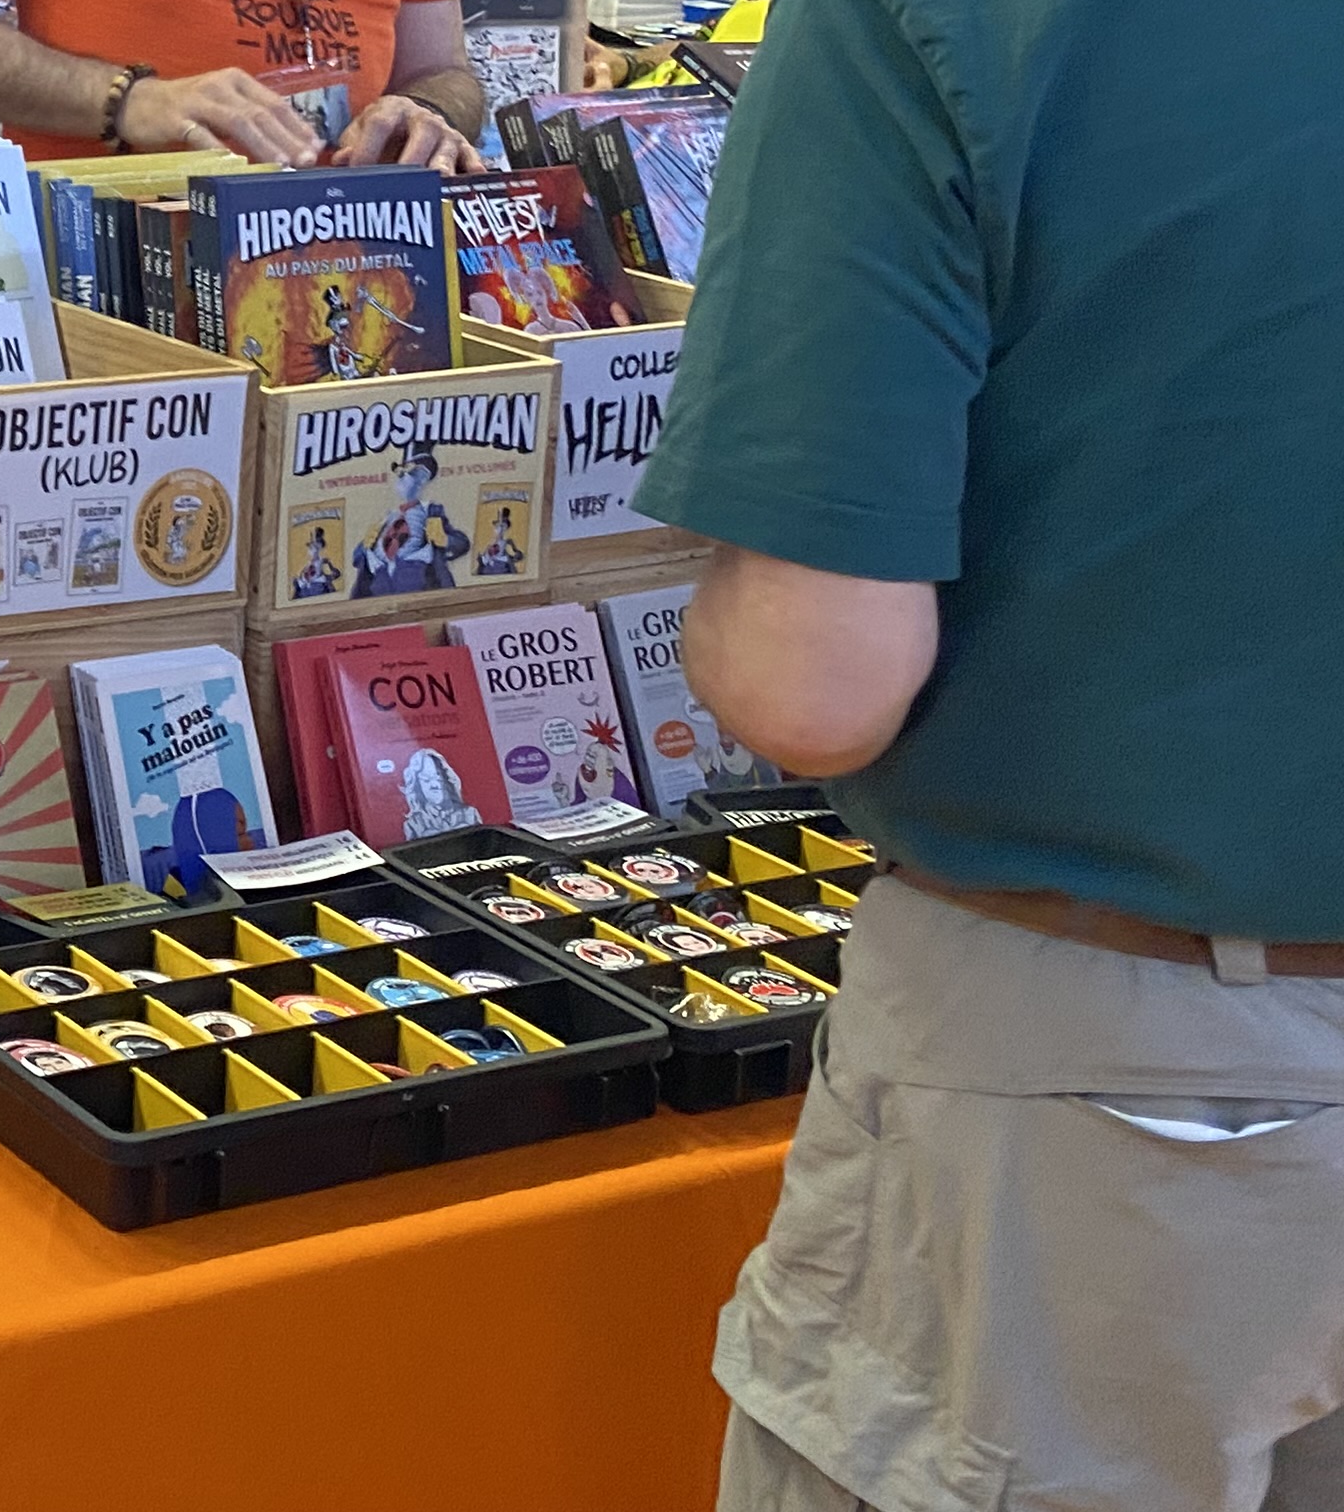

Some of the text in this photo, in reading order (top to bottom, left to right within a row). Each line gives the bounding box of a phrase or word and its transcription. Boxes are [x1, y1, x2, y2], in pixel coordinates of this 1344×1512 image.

[237, 200, 434, 262] HIROSHIMAN
[453, 192, 545, 246] HELLFEST
[264, 252, 414, 279] AU PAYS DU METAL
[144, 391, 212, 438] CON
[292, 392, 540, 476] HIROSHIMAN
[39, 448, 141, 493] (KLUB)
[481, 626, 579, 662] LE GROS
[627, 626, 641, 640] LE
[369, 672, 457, 711] CON
[486, 656, 598, 693] ROBERT
[137, 703, 214, 747] Y a pas
[140, 722, 229, 773] malouin
